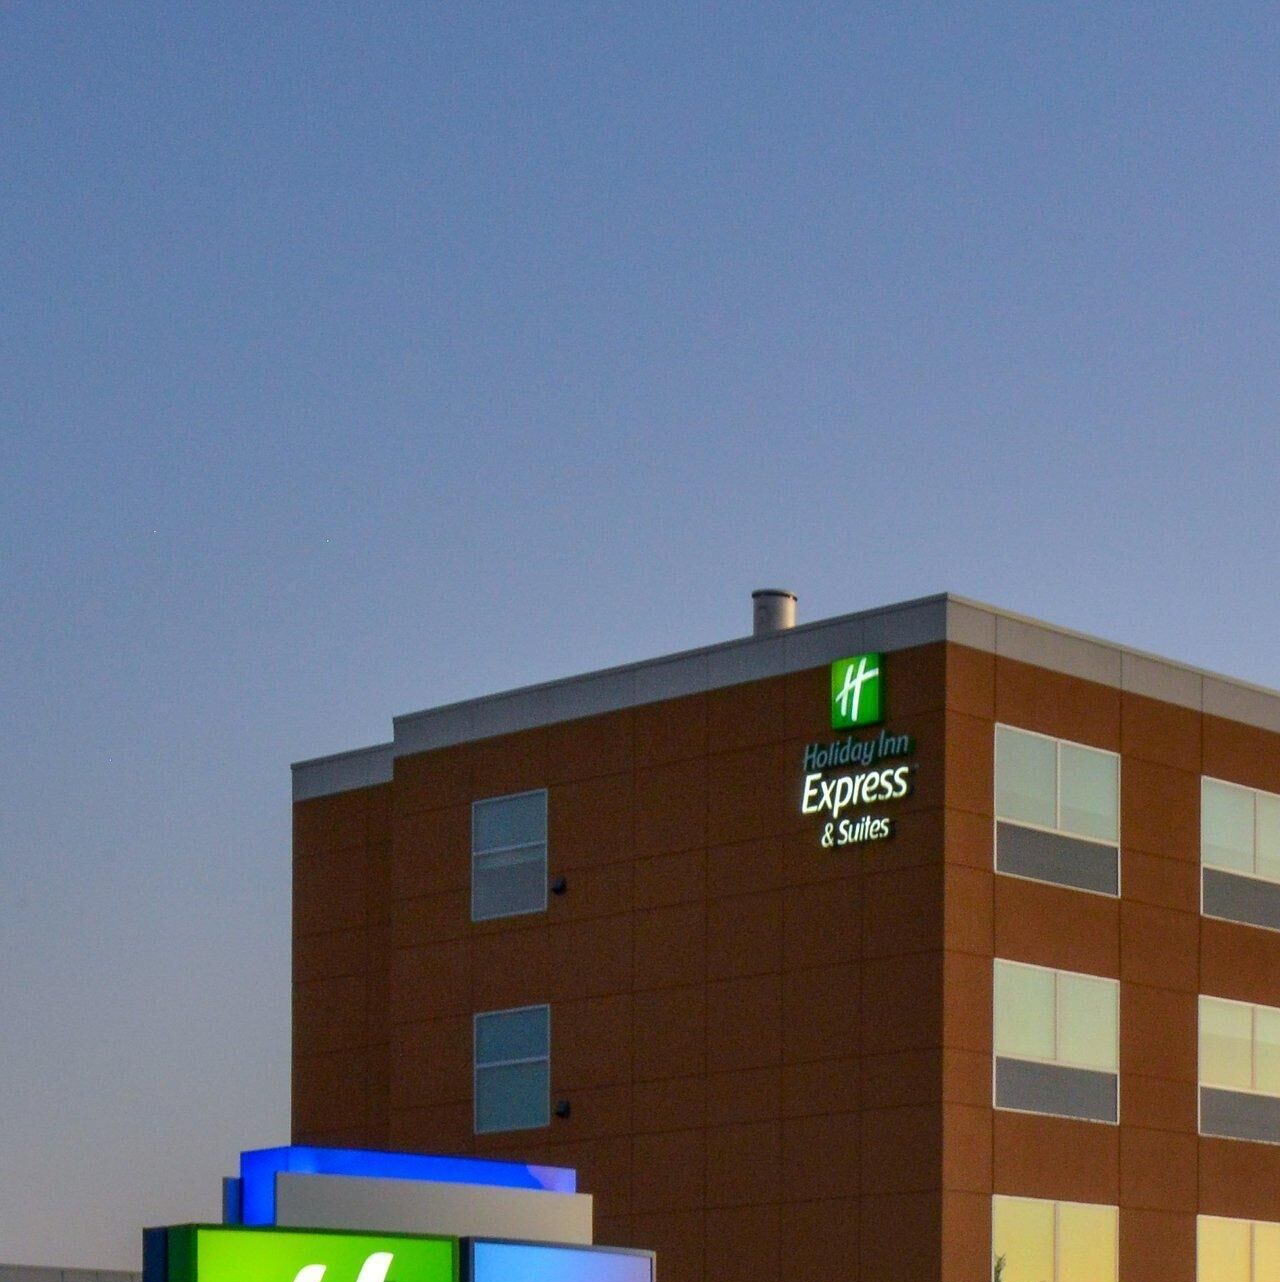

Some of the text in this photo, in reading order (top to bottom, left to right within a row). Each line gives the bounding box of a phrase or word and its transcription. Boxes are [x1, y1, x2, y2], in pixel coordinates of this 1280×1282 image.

[804, 730, 908, 770] Holiday Inn
[802, 766, 909, 818] Express
[821, 815, 890, 848] & Suites
